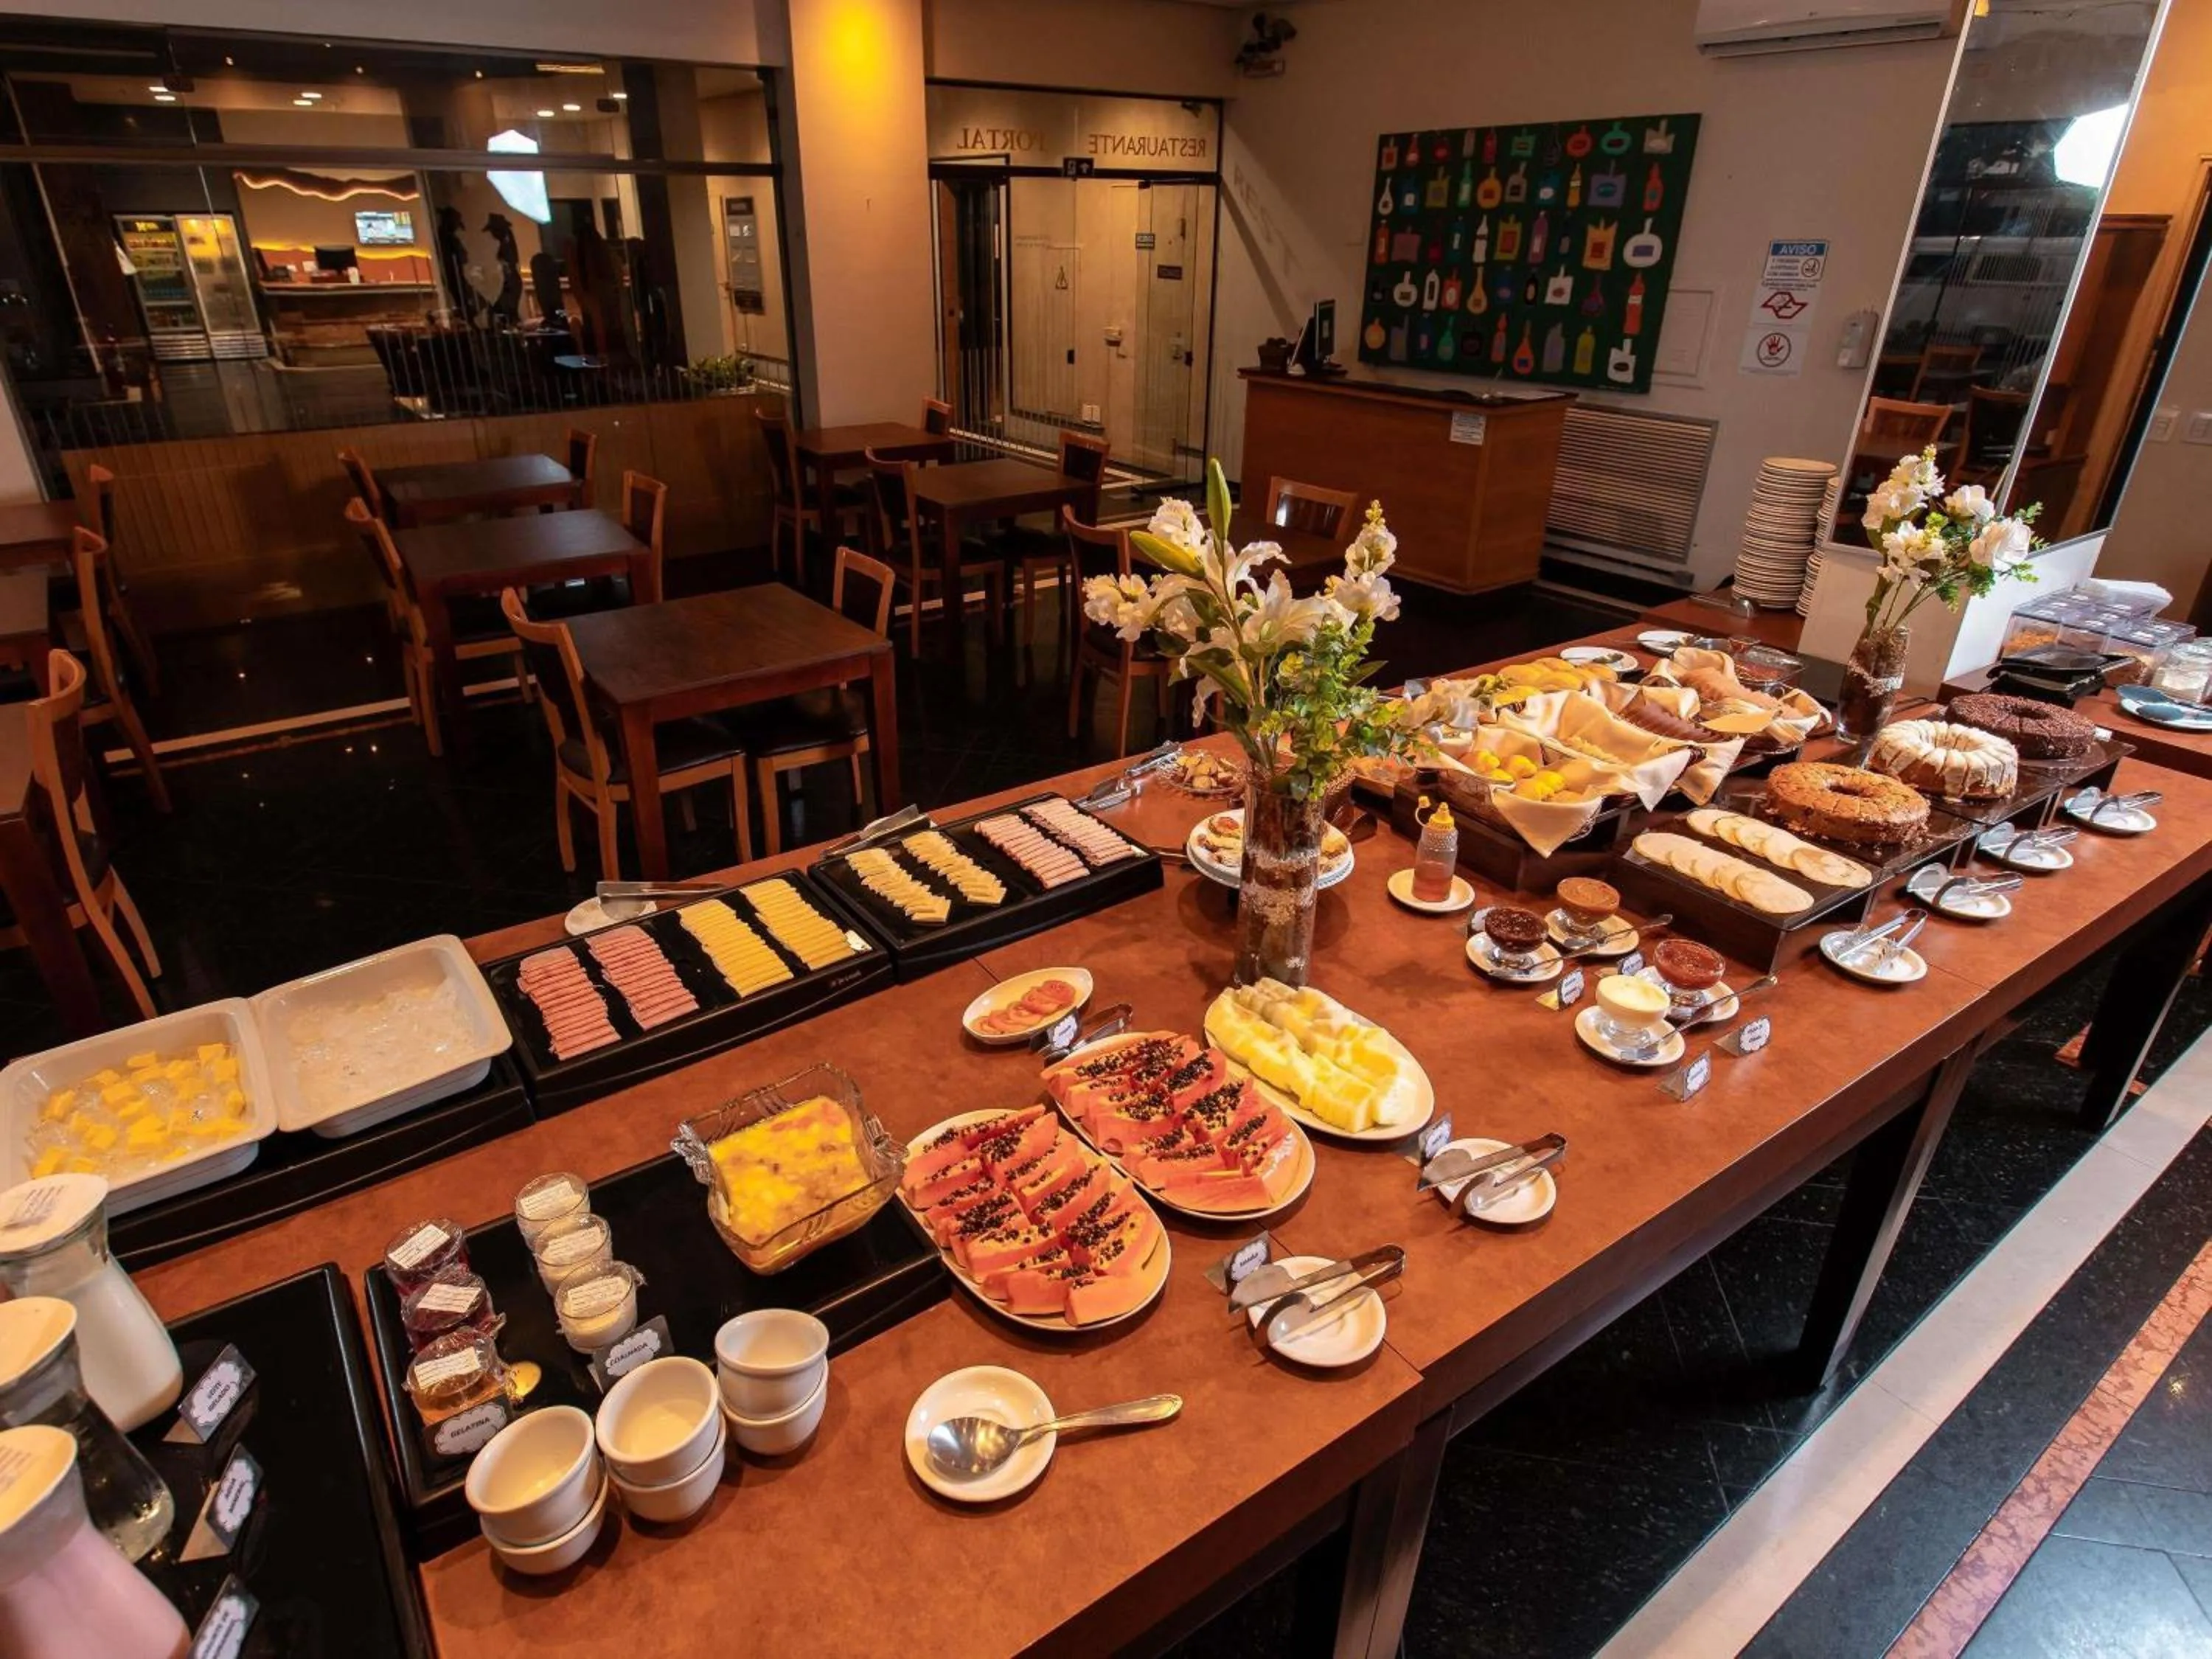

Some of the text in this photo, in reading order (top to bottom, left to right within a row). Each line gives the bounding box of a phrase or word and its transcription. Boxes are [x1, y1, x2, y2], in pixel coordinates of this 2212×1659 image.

[1779, 244, 1818, 254] AVISO
[610, 1342, 648, 1366] COALHADA
[451, 1416, 490, 1439] GELATINA
